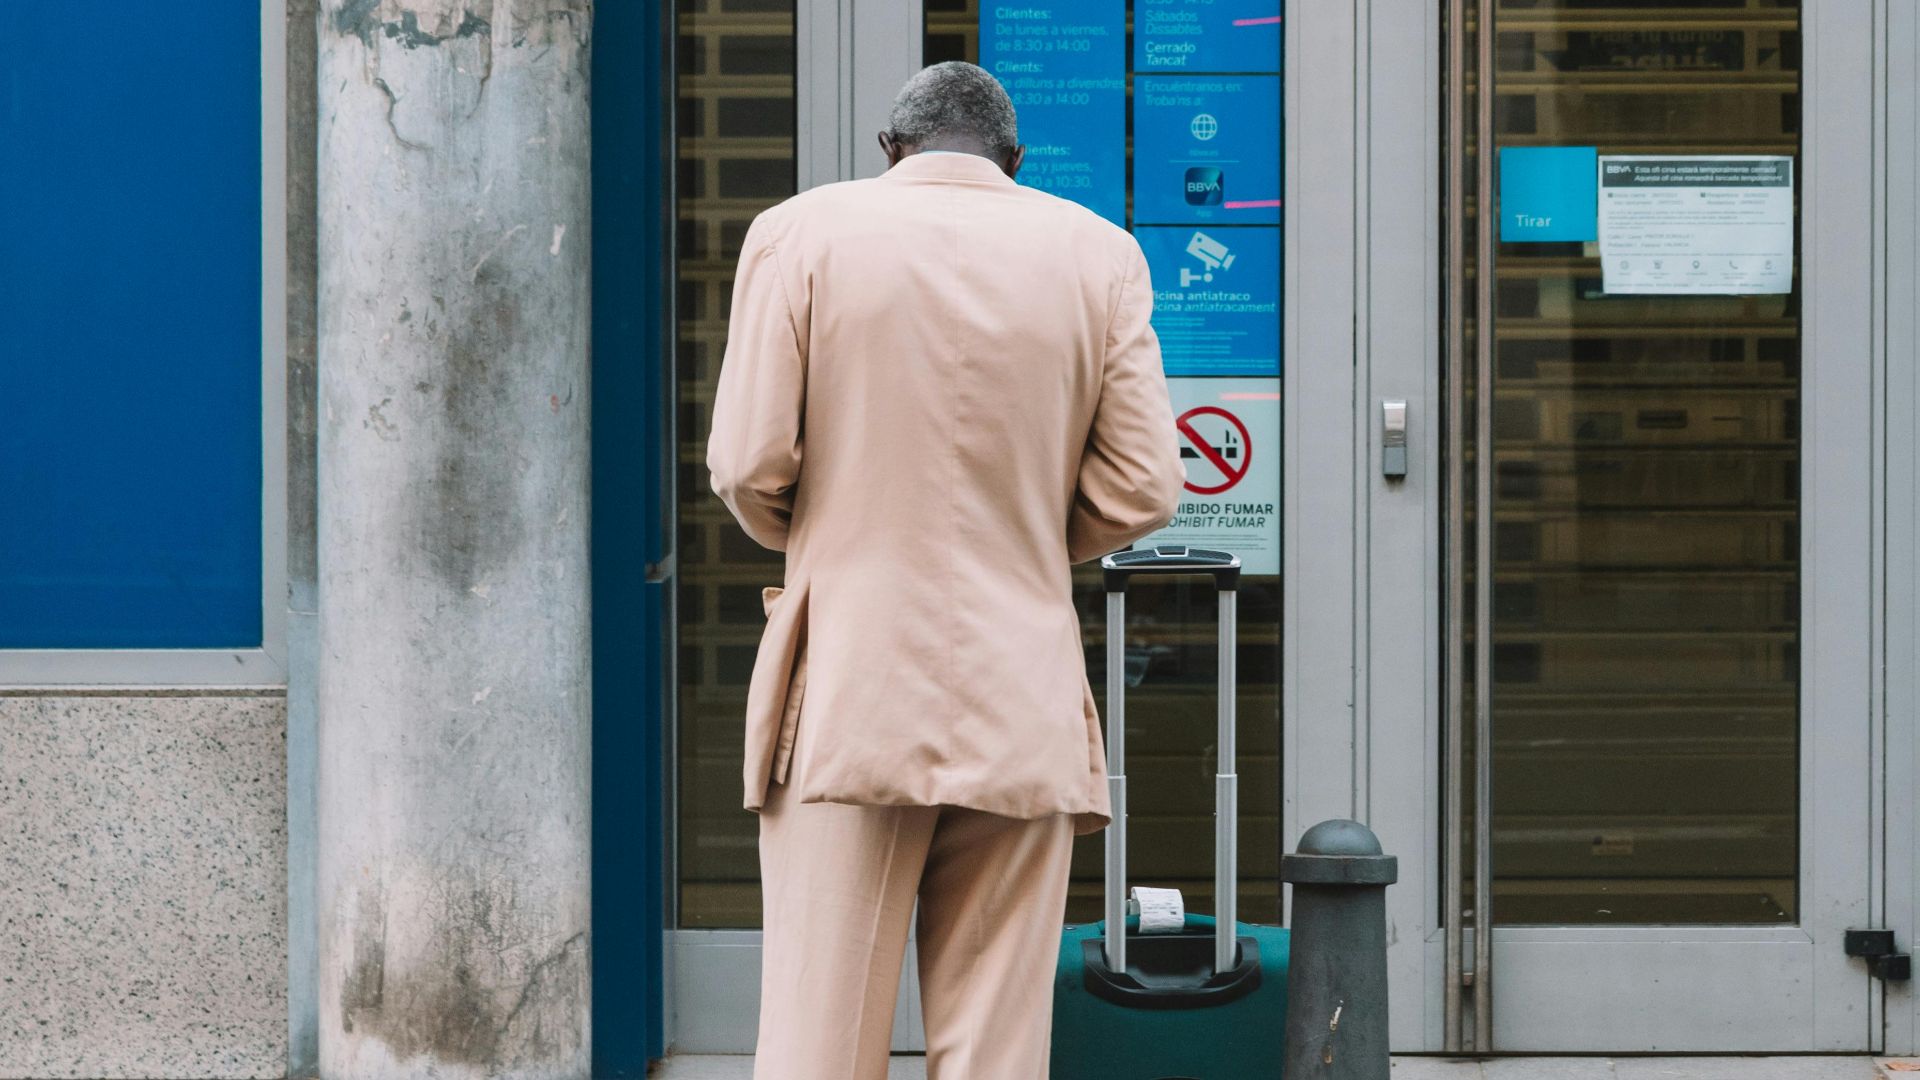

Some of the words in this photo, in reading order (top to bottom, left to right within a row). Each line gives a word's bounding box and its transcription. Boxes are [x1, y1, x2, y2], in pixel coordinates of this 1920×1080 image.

[995, 7, 1052, 19] Clientes:
[995, 23, 1013, 35] De
[1015, 23, 1049, 35] lunes
[1051, 26, 1059, 35] a
[995, 40, 1012, 51] de
[1045, 42, 1053, 51] a
[1056, 39, 1090, 51] 14:00
[1145, 41, 1196, 53] Cerrado
[1146, 54, 1187, 66] Tancat
[995, 61, 1044, 73] Clients:
[1056, 80, 1065, 88] a
[1043, 96, 1052, 105] a
[1055, 93, 1090, 105] 14:00
[1025, 144, 1072, 156] lientes:
[1607, 165, 1632, 174] BBVA
[1044, 178, 1053, 188] a
[1187, 182, 1221, 192] BBVA
[1515, 214, 1552, 227] Tirar
[1153, 290, 1184, 301] icina
[1187, 290, 1250, 301] antiatraco
[1184, 302, 1275, 312] antiatracament
[1178, 503, 1221, 514] IBIDO
[1225, 503, 1274, 514] FUMAR
[1168, 516, 1215, 528] OHIBIT
[1218, 516, 1267, 528] FUMAR
